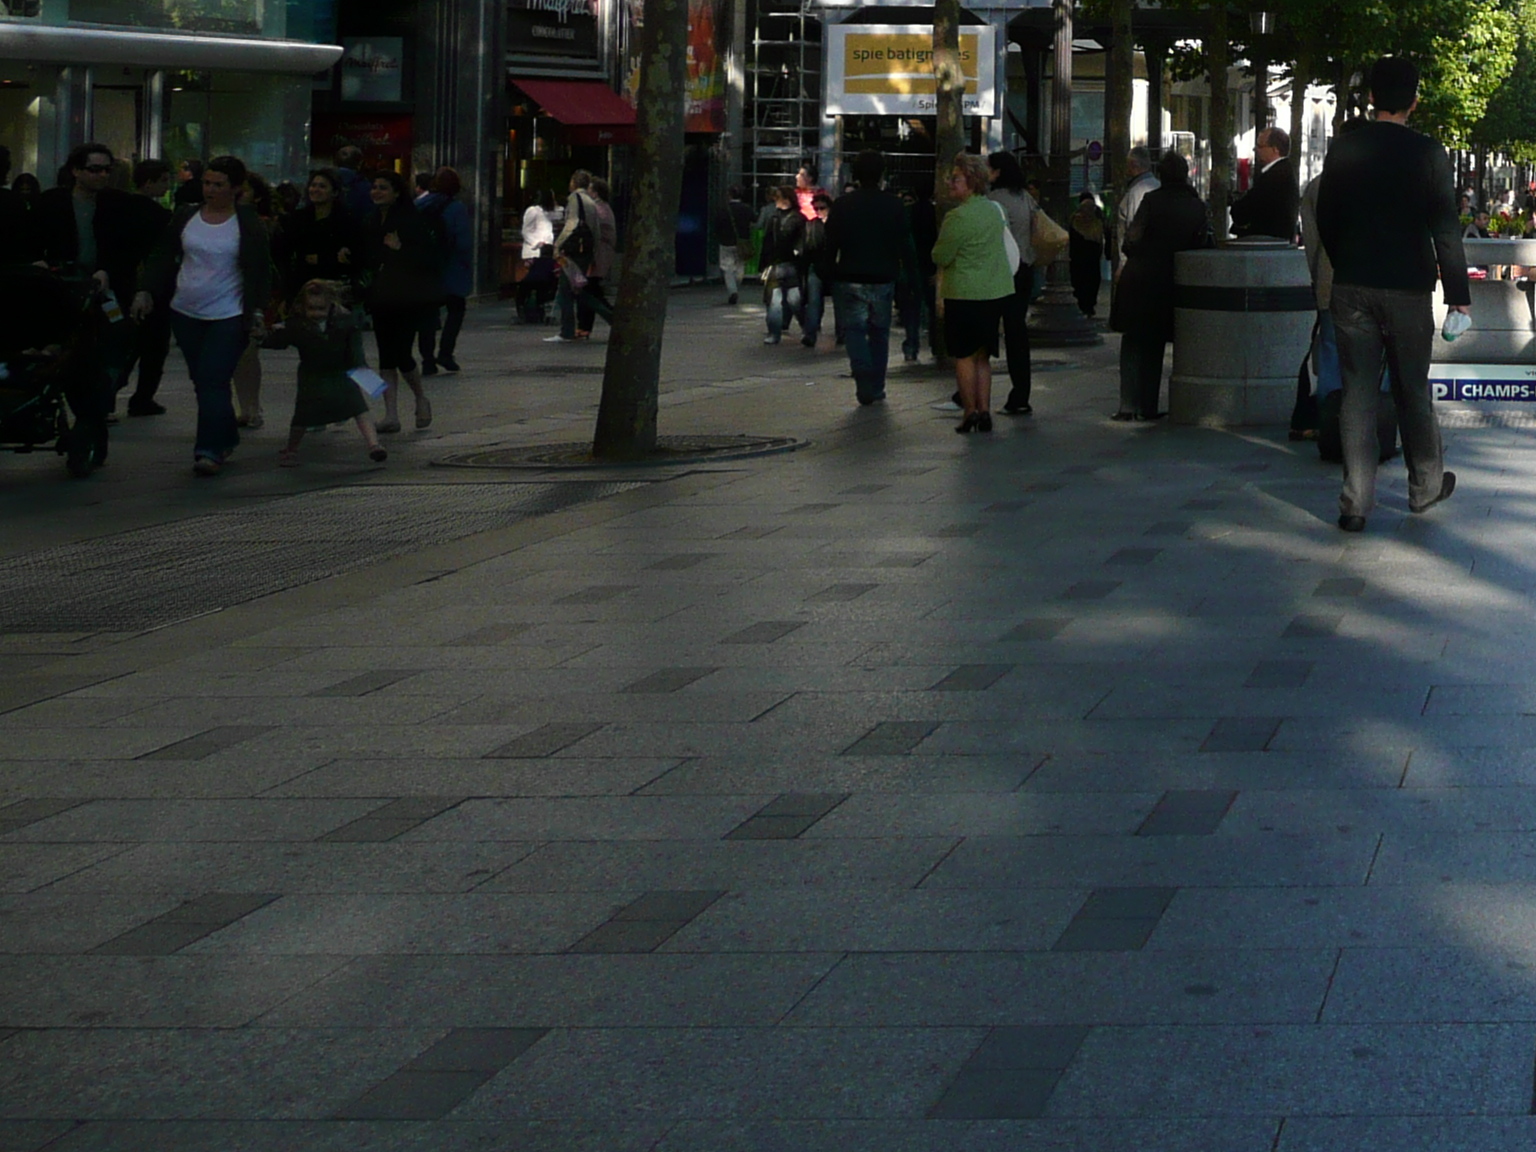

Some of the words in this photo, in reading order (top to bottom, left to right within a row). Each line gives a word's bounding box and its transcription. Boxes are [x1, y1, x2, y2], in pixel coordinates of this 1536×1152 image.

[853, 48, 884, 63] spie
[887, 47, 970, 63] batigns
[1432, 383, 1448, 401] P
